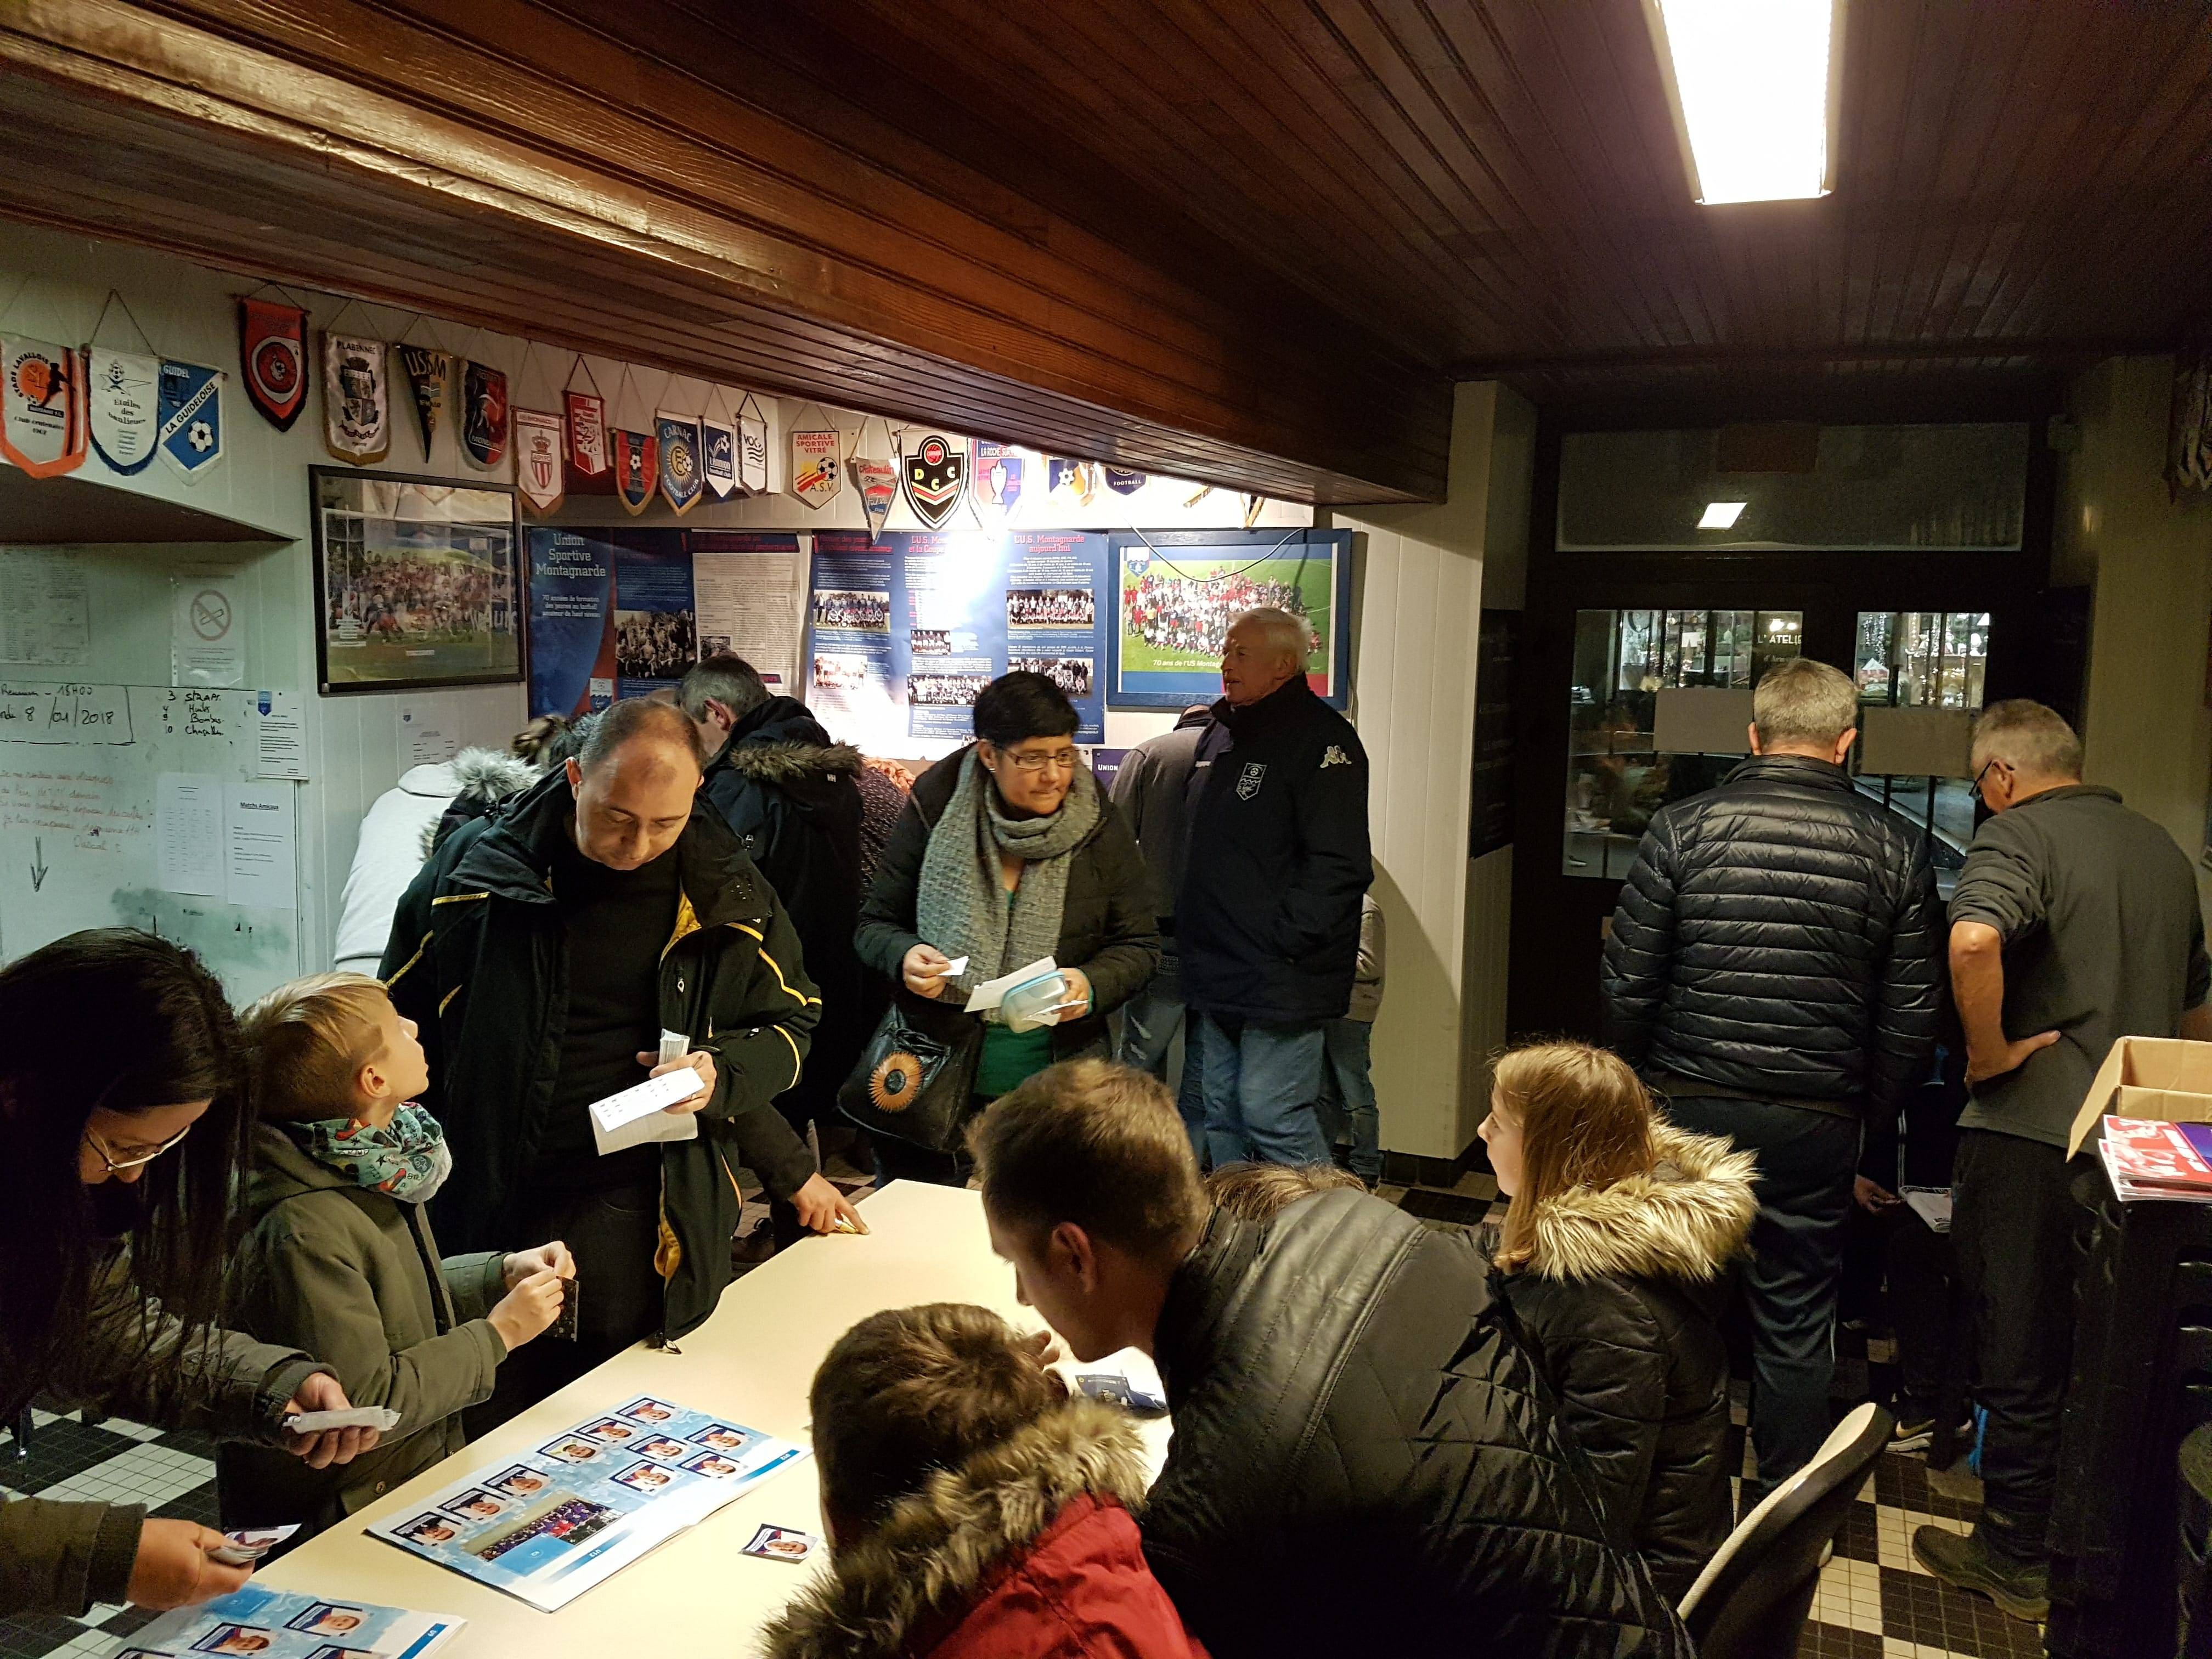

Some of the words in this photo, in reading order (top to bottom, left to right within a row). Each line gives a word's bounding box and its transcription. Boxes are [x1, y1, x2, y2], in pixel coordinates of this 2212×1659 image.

[13, 352, 49, 369] LAVALLOIS
[163, 365, 190, 379] GUIDEL
[10, 371, 25, 398] STADE
[166, 422, 177, 434] LA
[177, 381, 216, 423] GUIDELOISE
[664, 425, 692, 443] CARNAC
[914, 469, 924, 480] D
[931, 478, 939, 490] C
[946, 466, 955, 478] C
[664, 474, 687, 498] FOOTBALL
[687, 479, 699, 495] CLUB
[810, 482, 834, 492] A.S.V.
[553, 532, 585, 545] Union
[1037, 534, 1085, 545] Montagnarde
[549, 548, 592, 563] Sportive
[1029, 544, 1071, 554] aujourd'hui
[535, 562, 606, 579] Montagnarde
[168, 690, 176, 701] 3
[589, 1549, 602, 1558] U13
